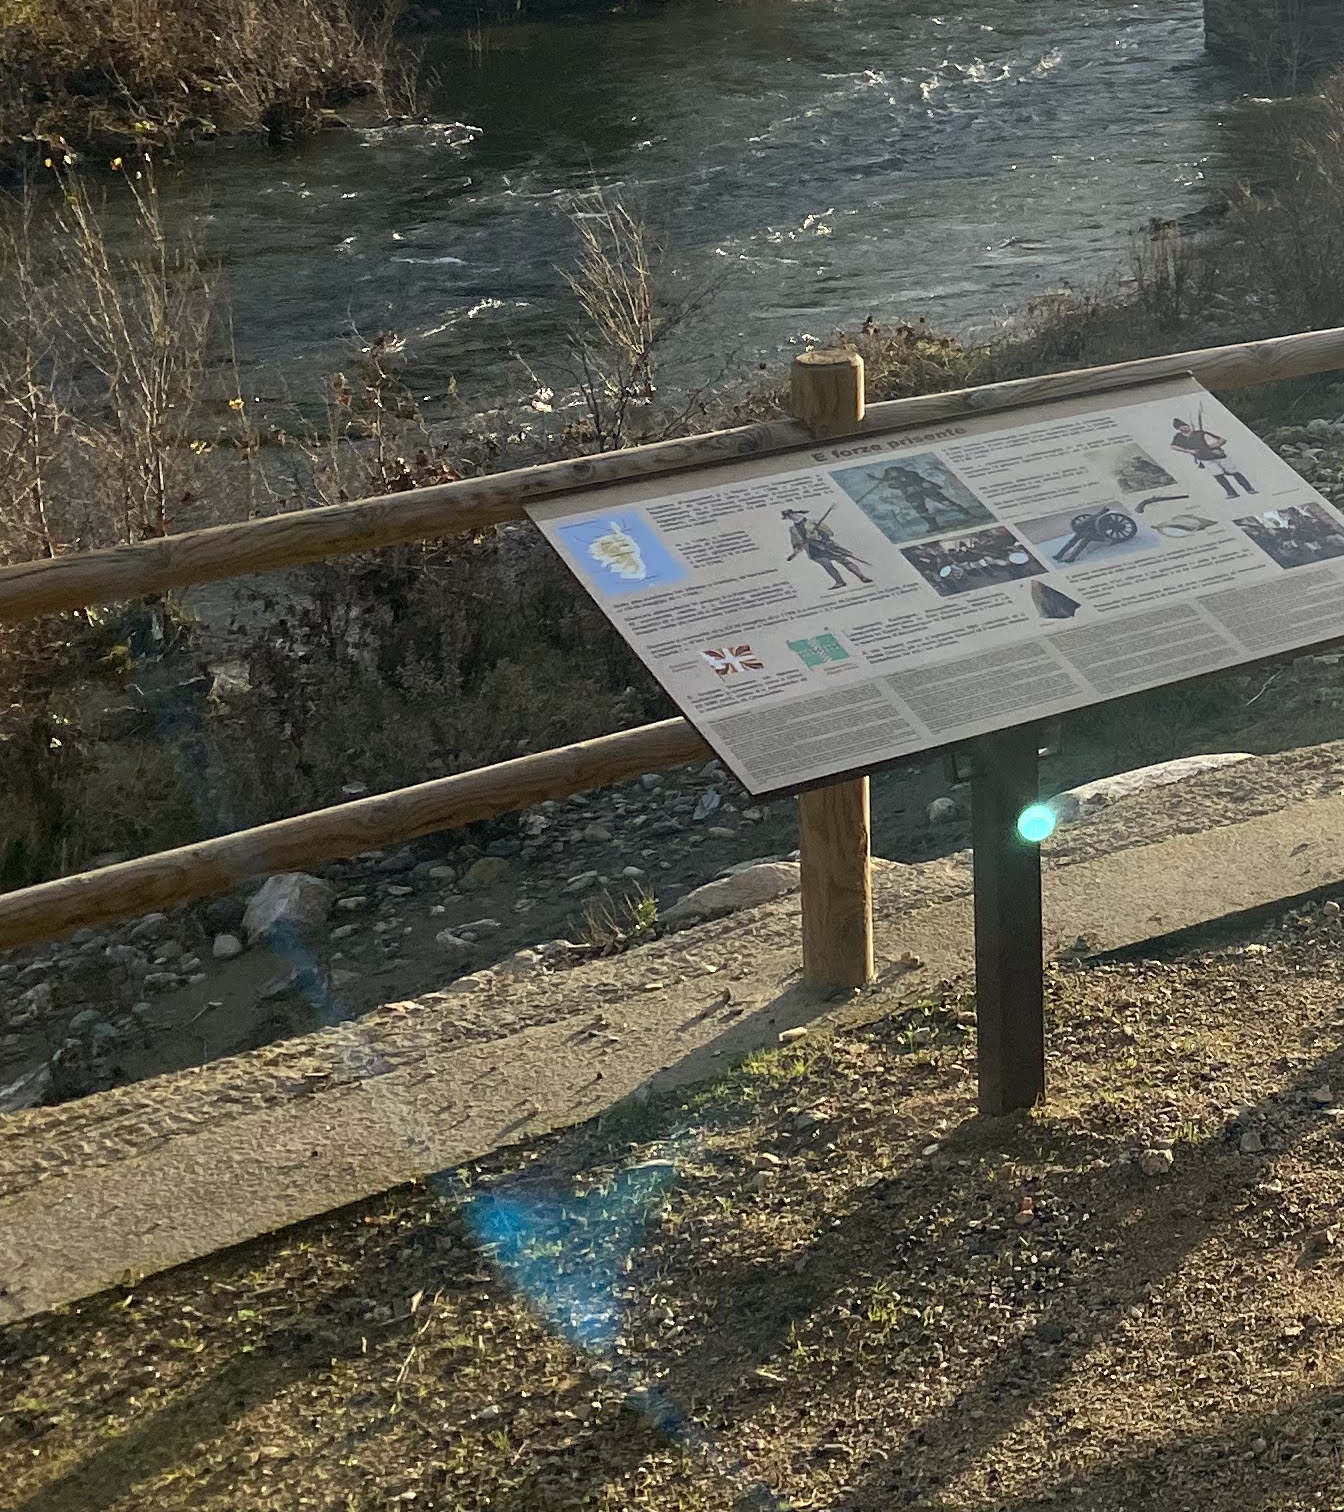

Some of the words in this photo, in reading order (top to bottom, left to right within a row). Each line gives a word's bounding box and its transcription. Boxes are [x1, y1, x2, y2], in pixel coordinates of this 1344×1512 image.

[811, 452, 829, 463] E
[831, 443, 883, 459] forze
[886, 427, 968, 449] prisente
